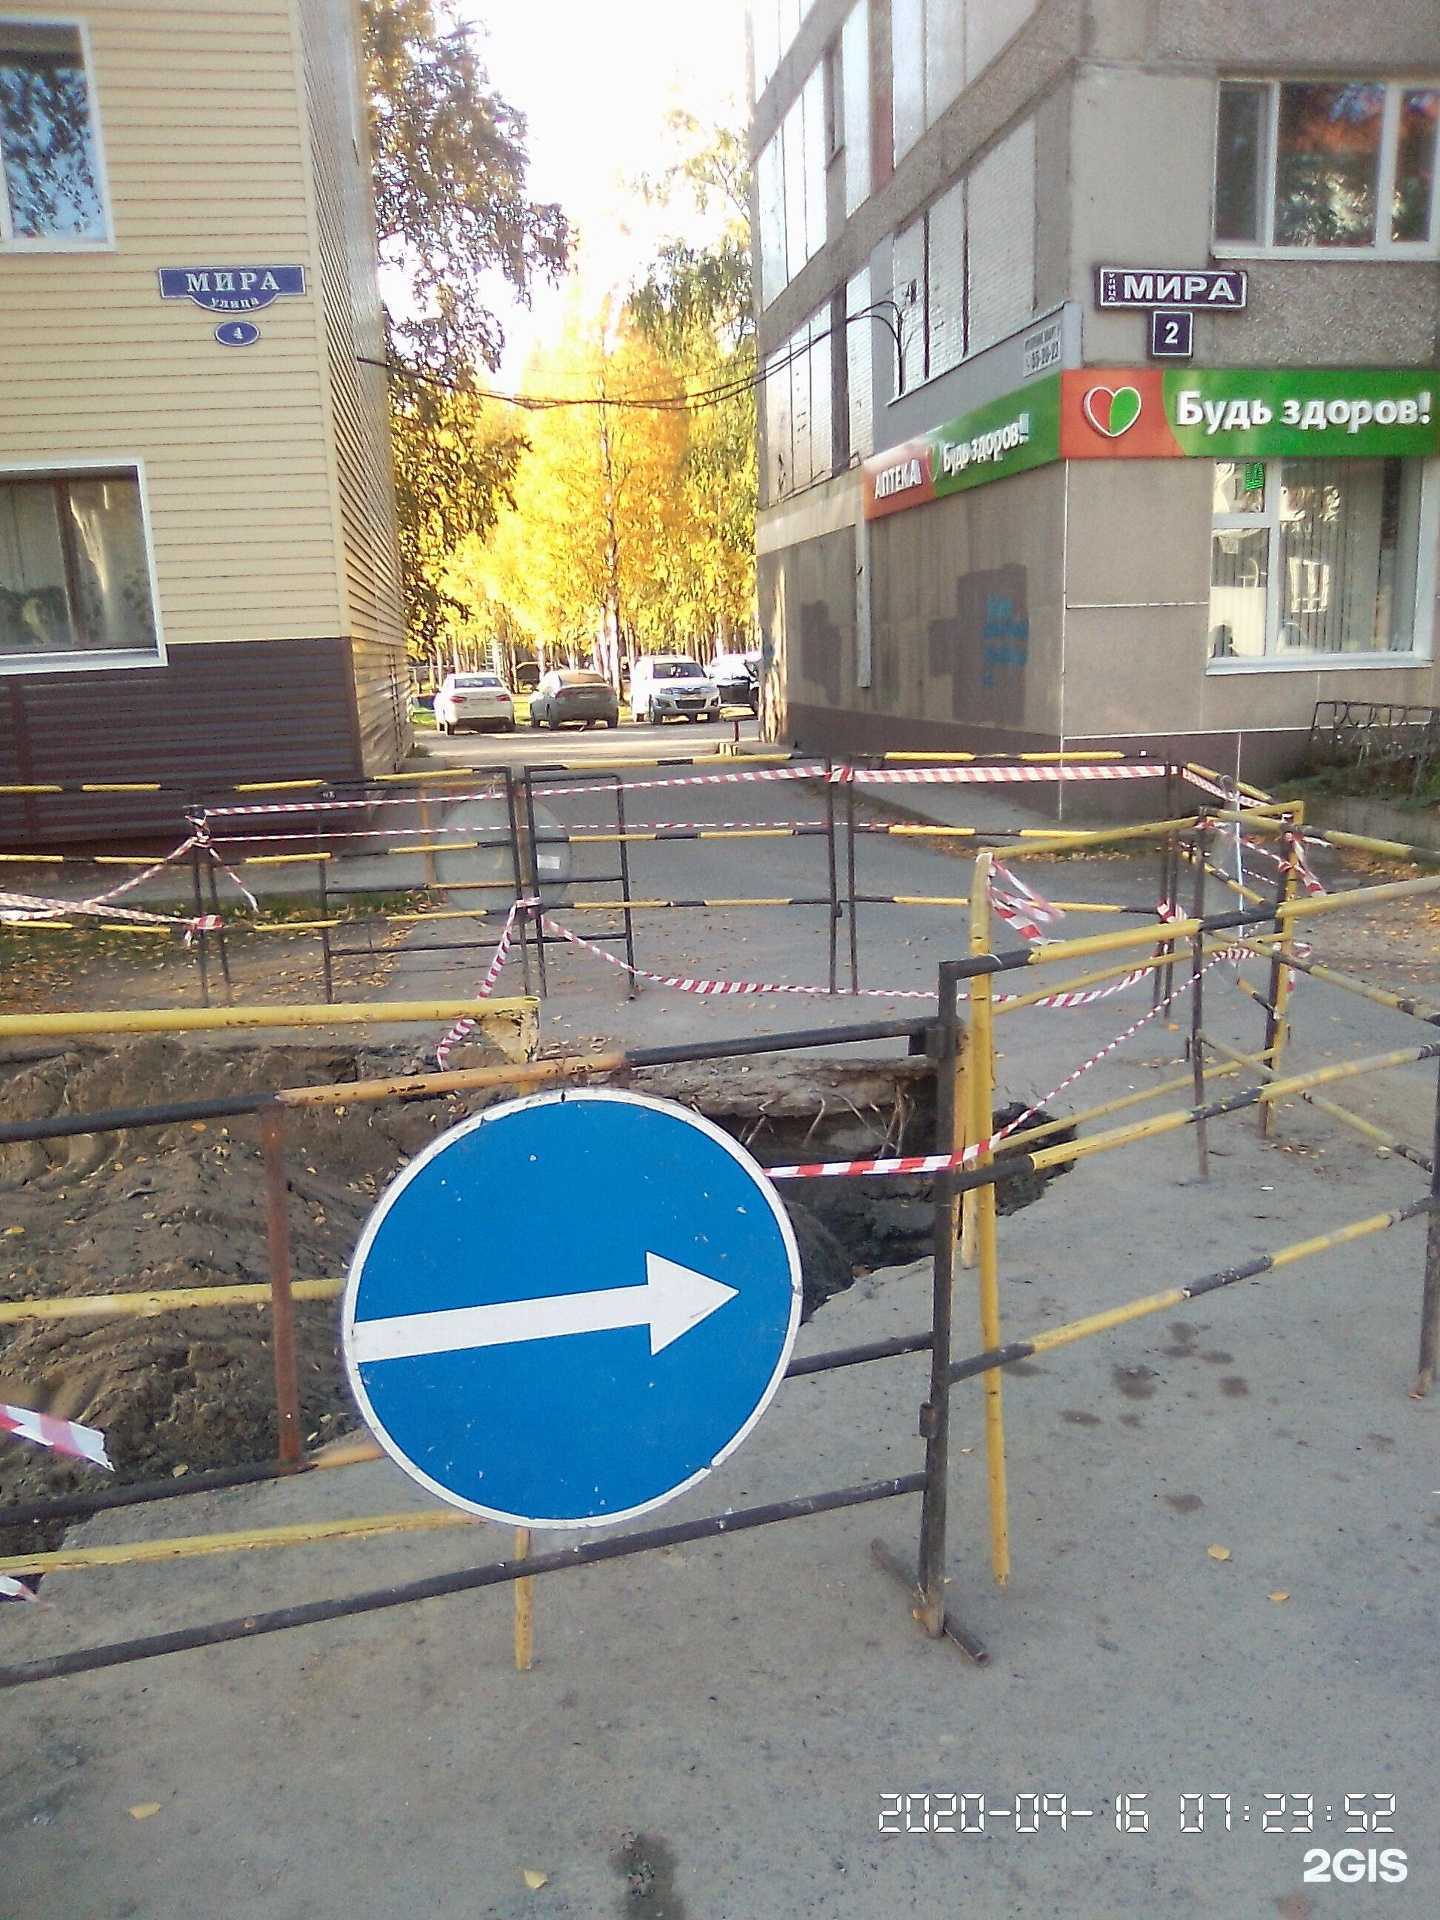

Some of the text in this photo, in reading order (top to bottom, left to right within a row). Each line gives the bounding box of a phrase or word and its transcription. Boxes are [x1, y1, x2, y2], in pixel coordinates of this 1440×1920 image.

[186, 272, 281, 292] МИРА
[1124, 274, 1235, 302] МИРА
[233, 327, 243, 339] 4
[1164, 321, 1180, 345] 2
[1175, 390, 1432, 436] Будь здоров!
[875, 459, 922, 499] АПТЕКА
